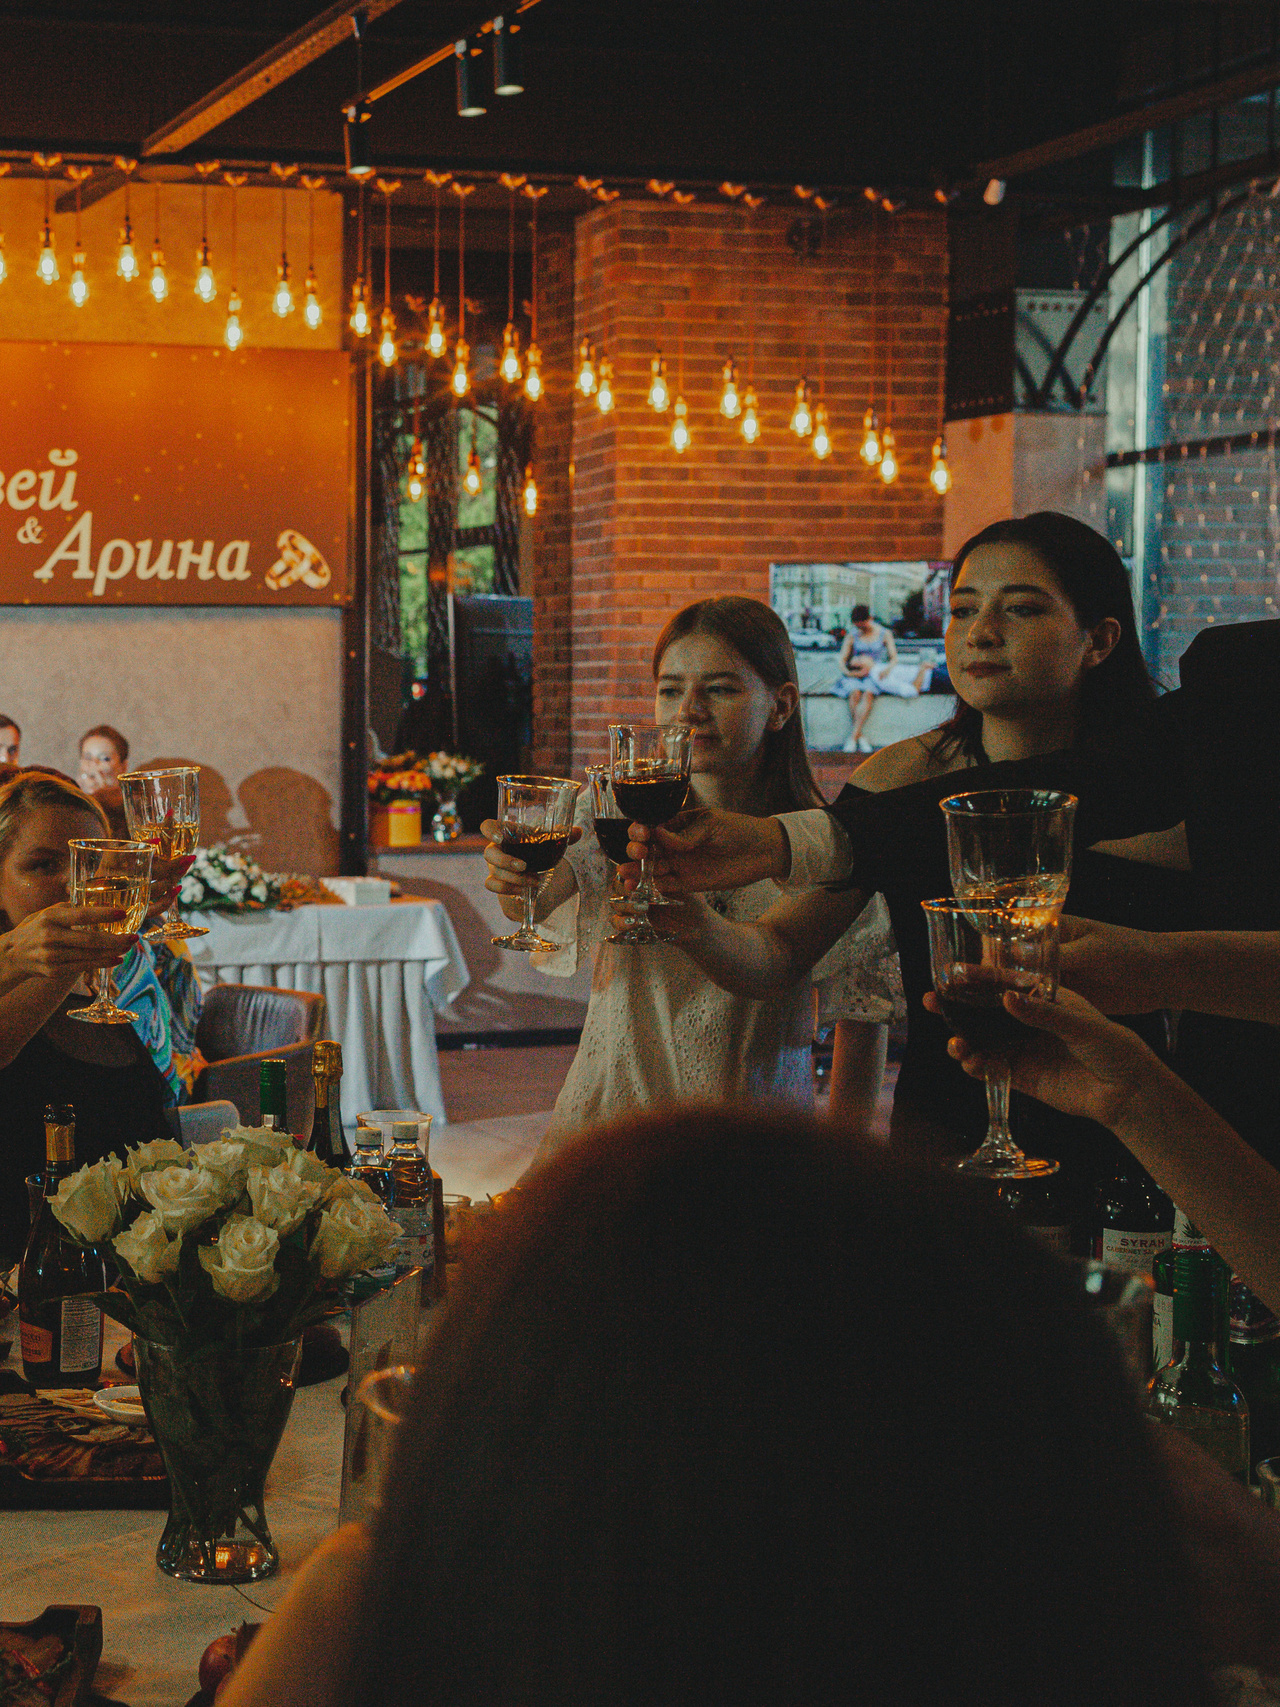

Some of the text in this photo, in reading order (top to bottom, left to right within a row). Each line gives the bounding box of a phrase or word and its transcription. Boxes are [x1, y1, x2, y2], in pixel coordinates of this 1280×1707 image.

[17, 516, 44, 545] &
[33, 510, 251, 596] Арина
[1120, 1237, 1165, 1248] SYRAH
